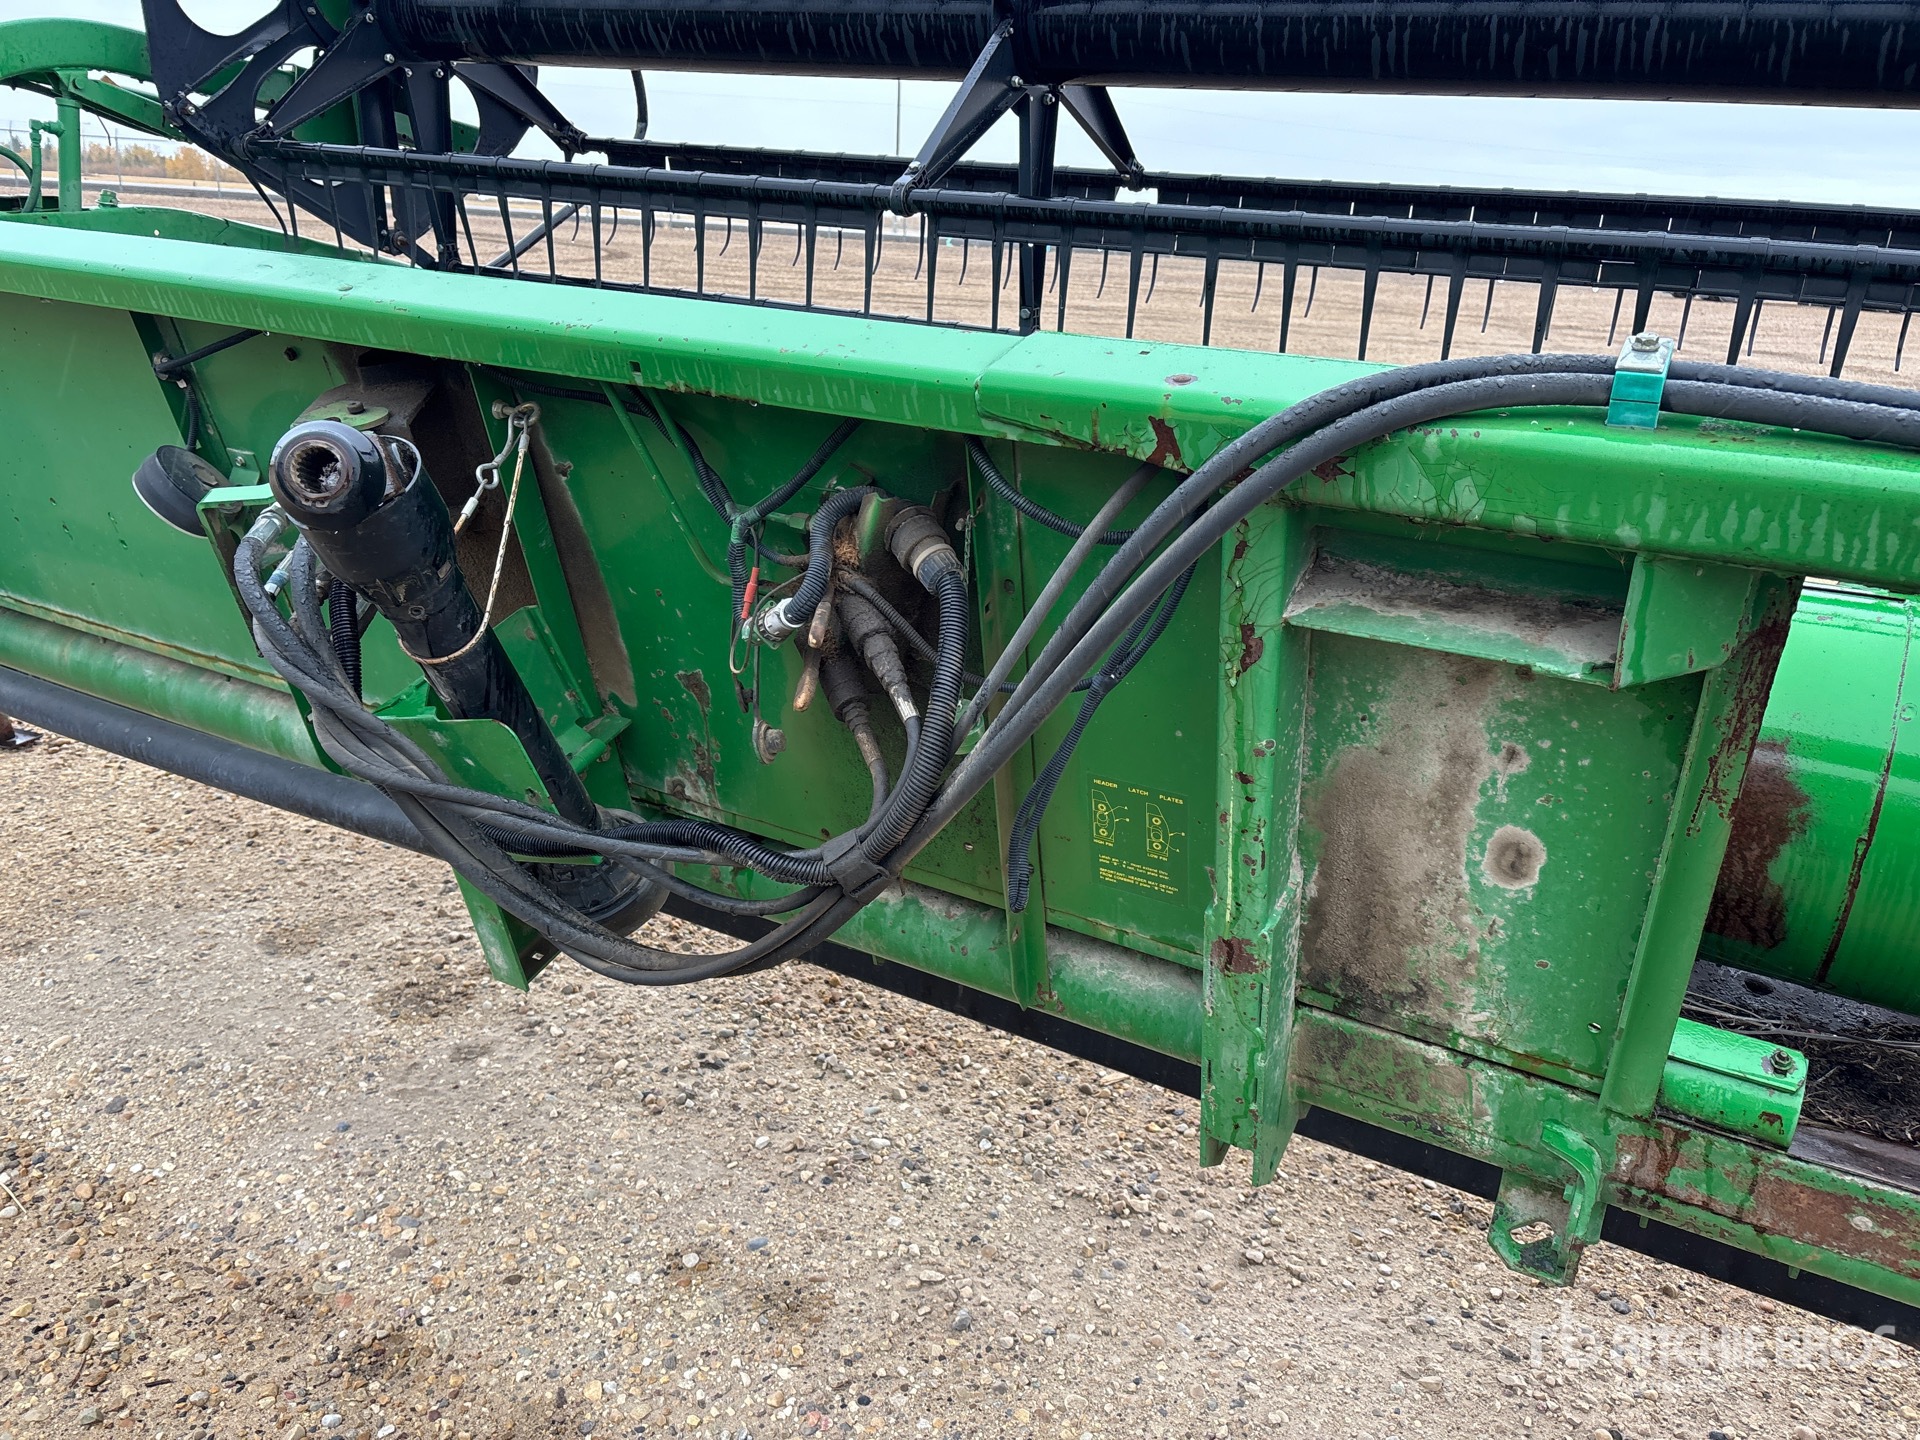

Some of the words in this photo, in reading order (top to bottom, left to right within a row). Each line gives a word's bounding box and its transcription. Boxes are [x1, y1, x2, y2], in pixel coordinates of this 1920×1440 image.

[1093, 779, 1118, 788] HEADER
[1128, 787, 1148, 796] LATCH
[1159, 794, 1183, 804] PLATES
[1128, 875, 1147, 883] HEADER
[1159, 884, 1179, 892] DETACH
